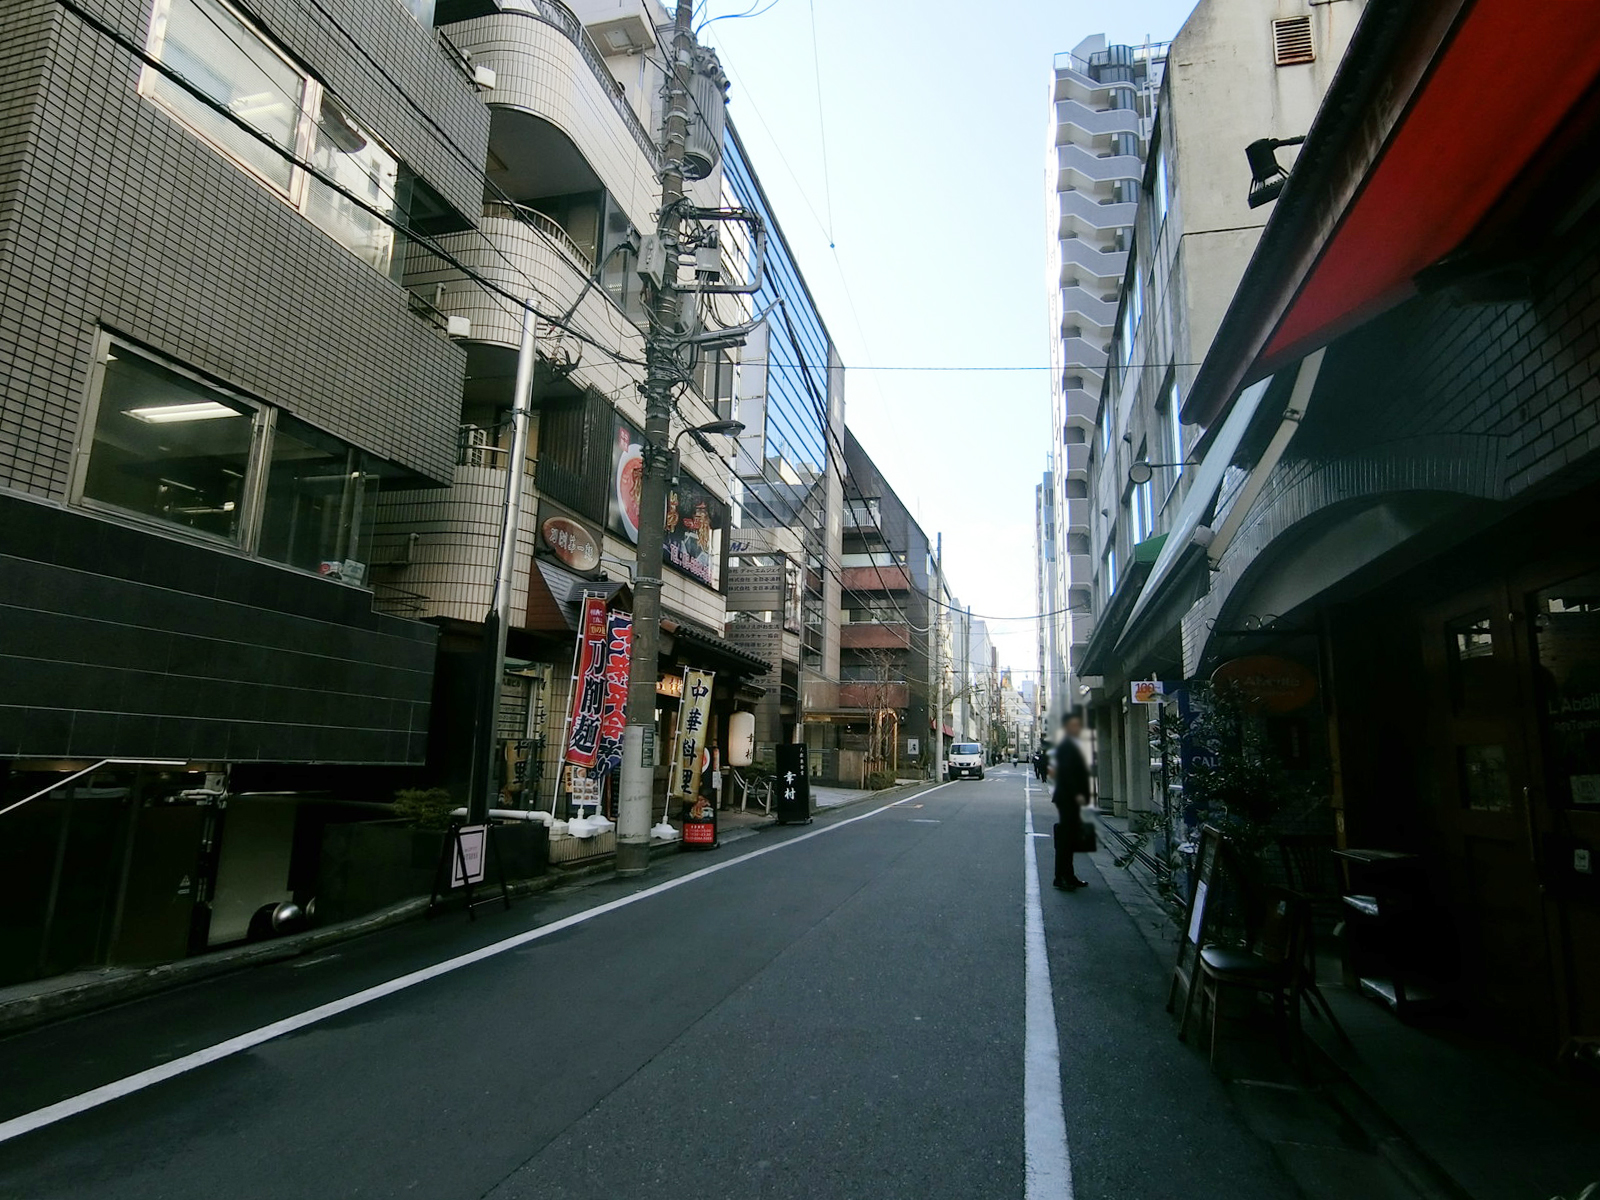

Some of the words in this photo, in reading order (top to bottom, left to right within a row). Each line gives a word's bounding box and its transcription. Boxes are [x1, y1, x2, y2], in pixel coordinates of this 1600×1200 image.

[569, 639, 606, 755] 刀削麺
[680, 679, 710, 795] 中華料理
[783, 770, 797, 801] 幸村
